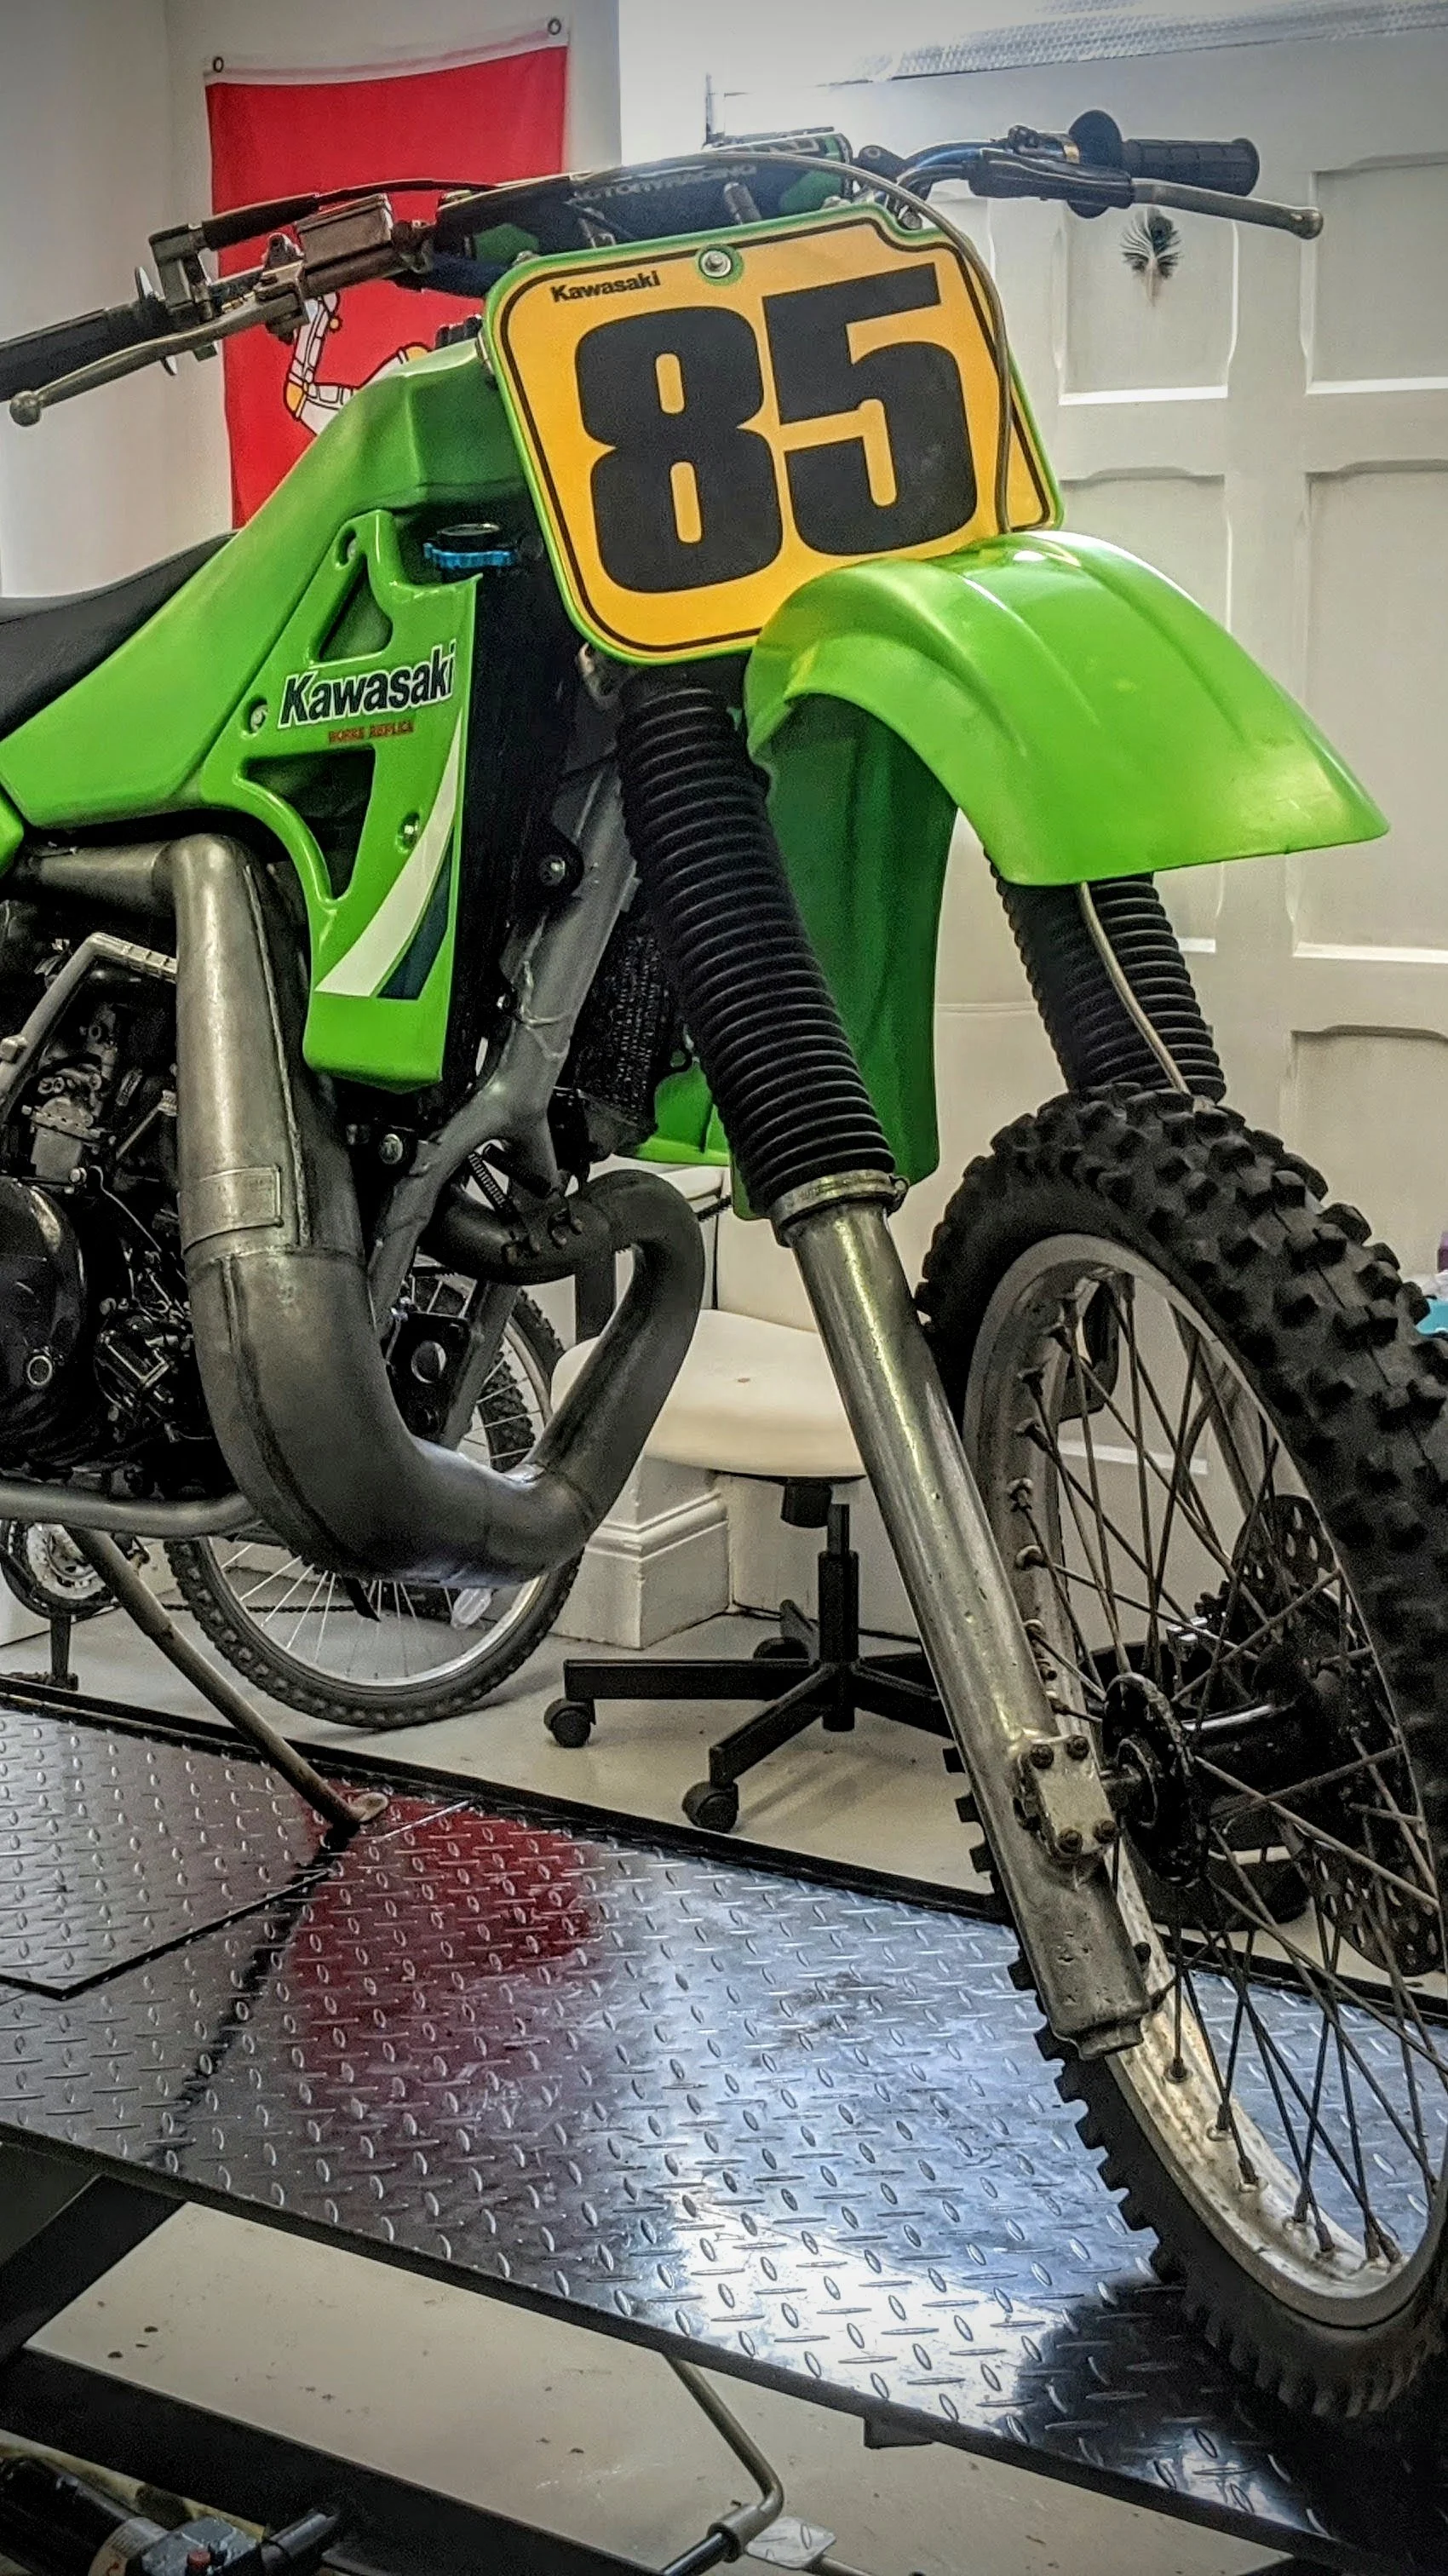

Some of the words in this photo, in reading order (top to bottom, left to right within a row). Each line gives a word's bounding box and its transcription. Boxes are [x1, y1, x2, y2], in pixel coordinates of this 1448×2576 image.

[550, 270, 661, 302] Kawasaki
[575, 262, 978, 594] 85
[277, 639, 457, 729] Kawasaki
